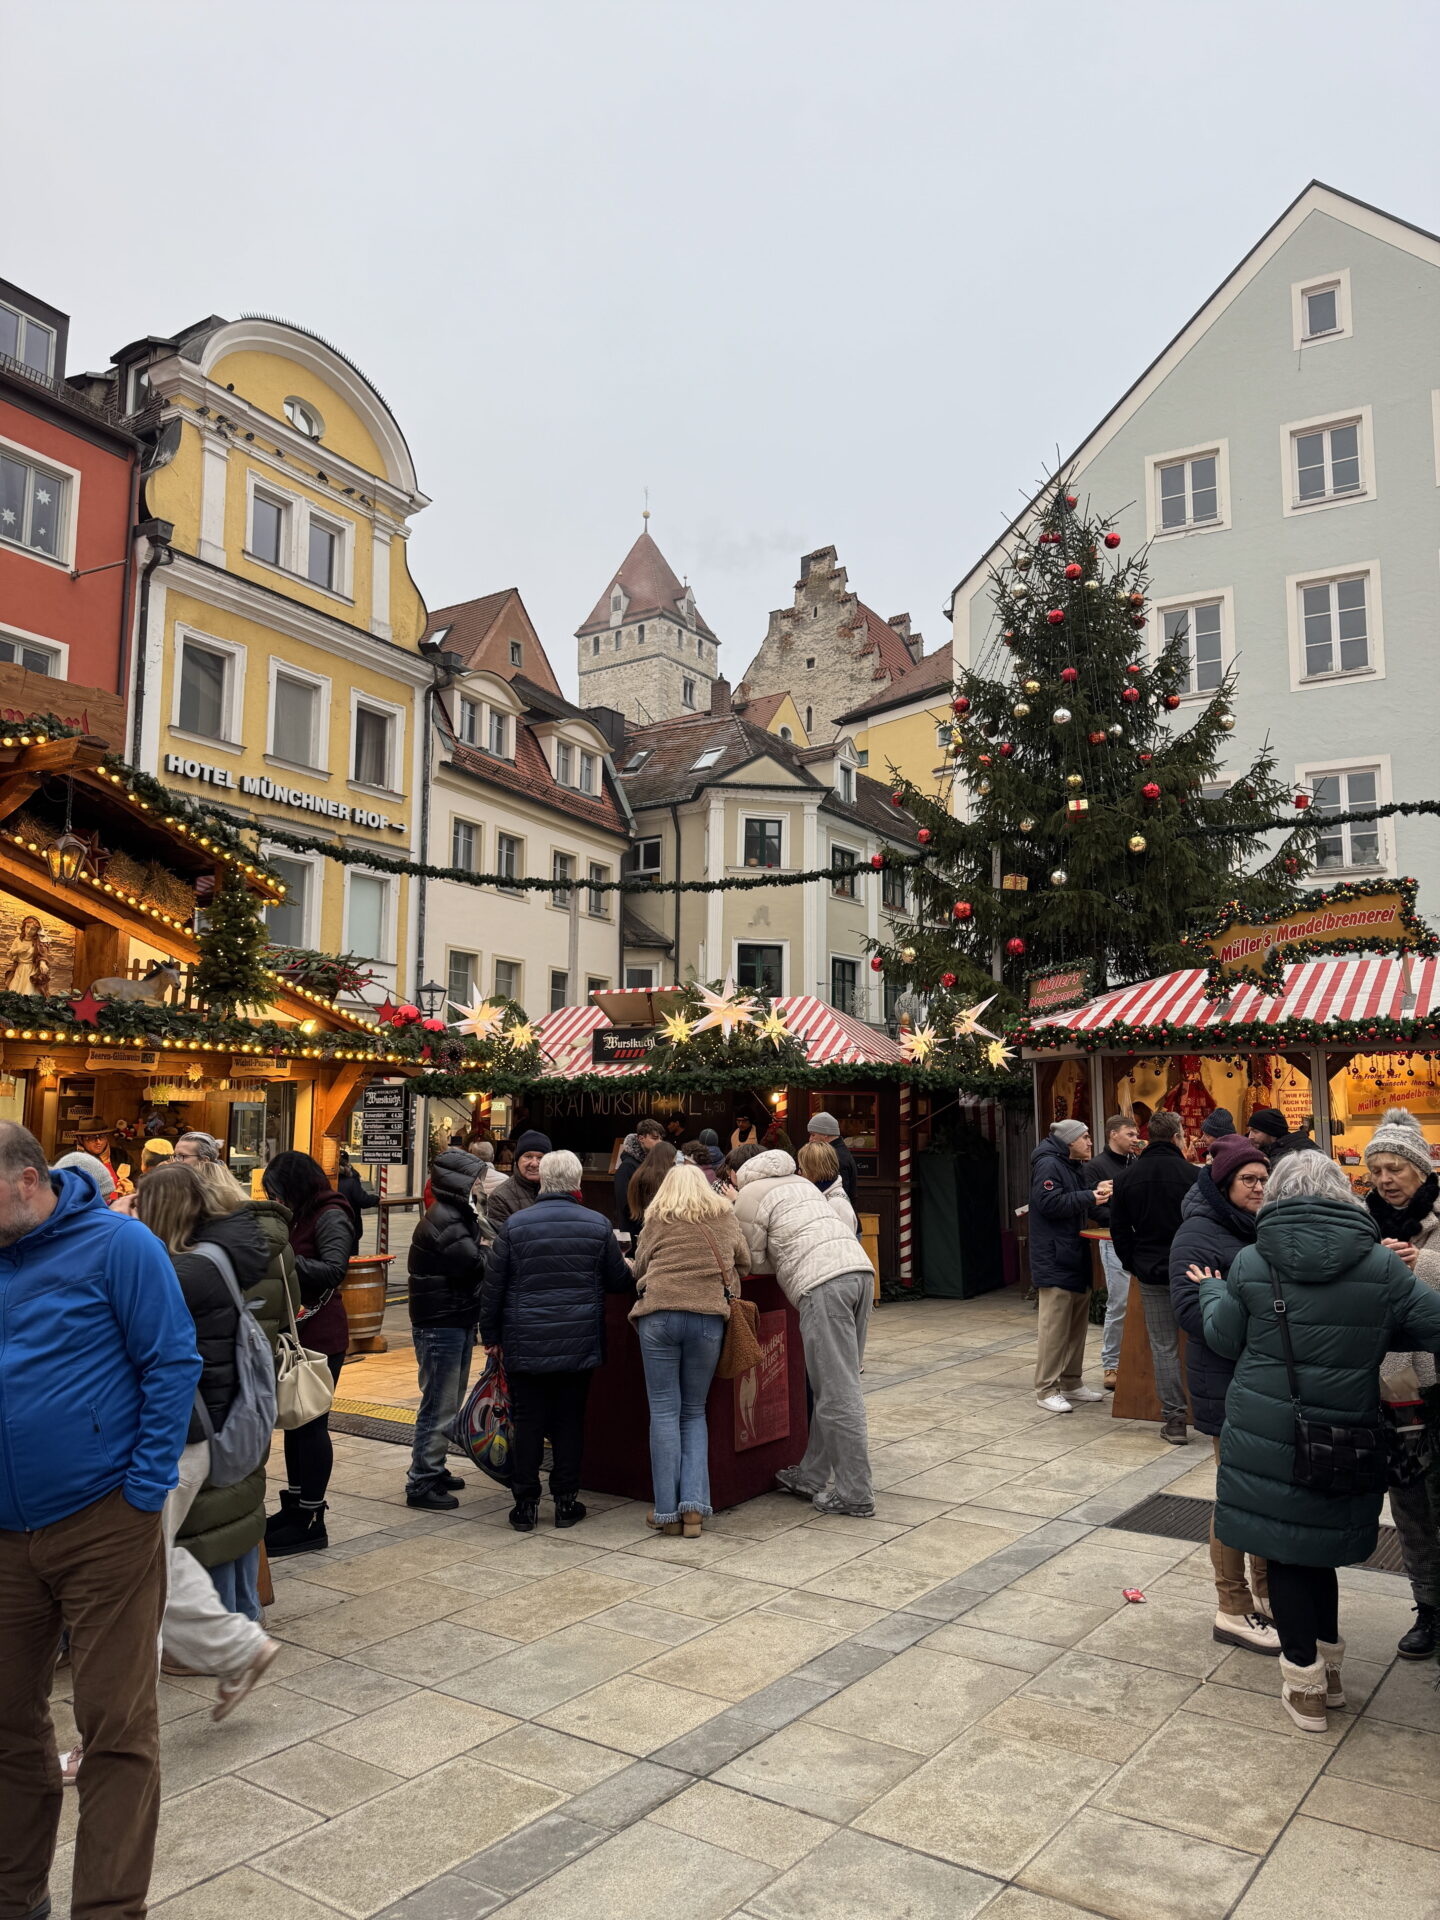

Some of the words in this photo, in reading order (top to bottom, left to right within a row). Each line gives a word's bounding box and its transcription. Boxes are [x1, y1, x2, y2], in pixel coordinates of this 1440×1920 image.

[165, 754, 237, 789] HOTEL
[242, 776, 350, 820] MÜNCHNER
[353, 808, 389, 830] HOF
[1276, 904, 1397, 944] Mandelbrennerei
[1389, 1088, 1440, 1103] Mandelbrenn
